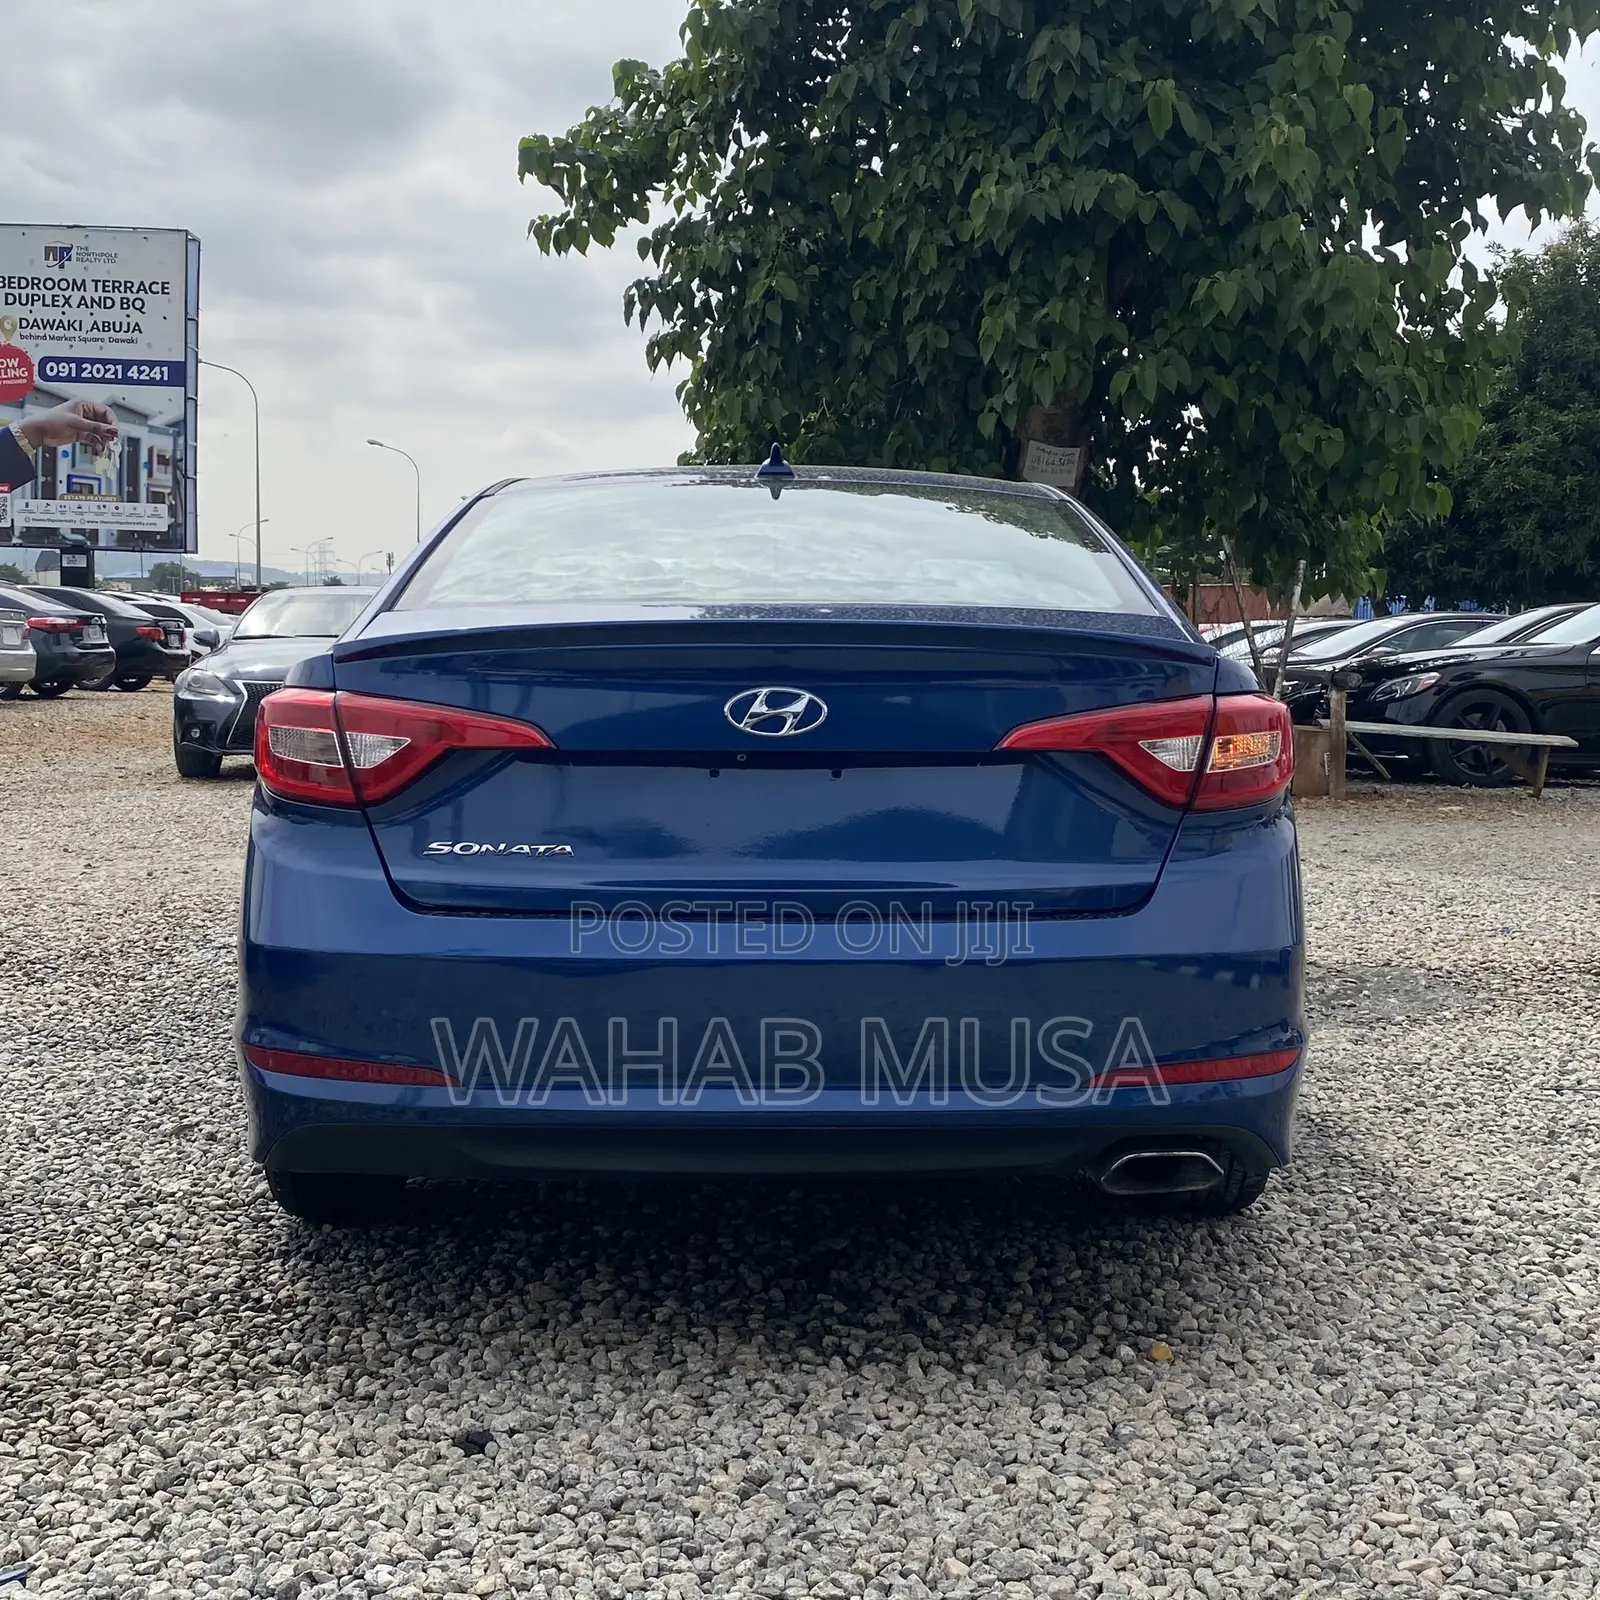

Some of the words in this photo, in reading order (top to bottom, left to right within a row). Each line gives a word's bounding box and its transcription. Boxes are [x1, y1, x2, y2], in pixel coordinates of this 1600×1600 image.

[0, 276, 86, 292] BEDROOM
[92, 279, 170, 295] TERRACE
[4, 292, 72, 308] DUPLEX
[76, 296, 116, 310] AND
[120, 298, 146, 314] BQ
[18, 318, 82, 332] DAWAKI
[20, 332, 47, 341] behind
[49, 334, 76, 342] Market
[46, 362, 76, 376] 091
[80, 364, 123, 378] 2021
[127, 366, 169, 380] 4241
[422, 842, 574, 856] SONATA
